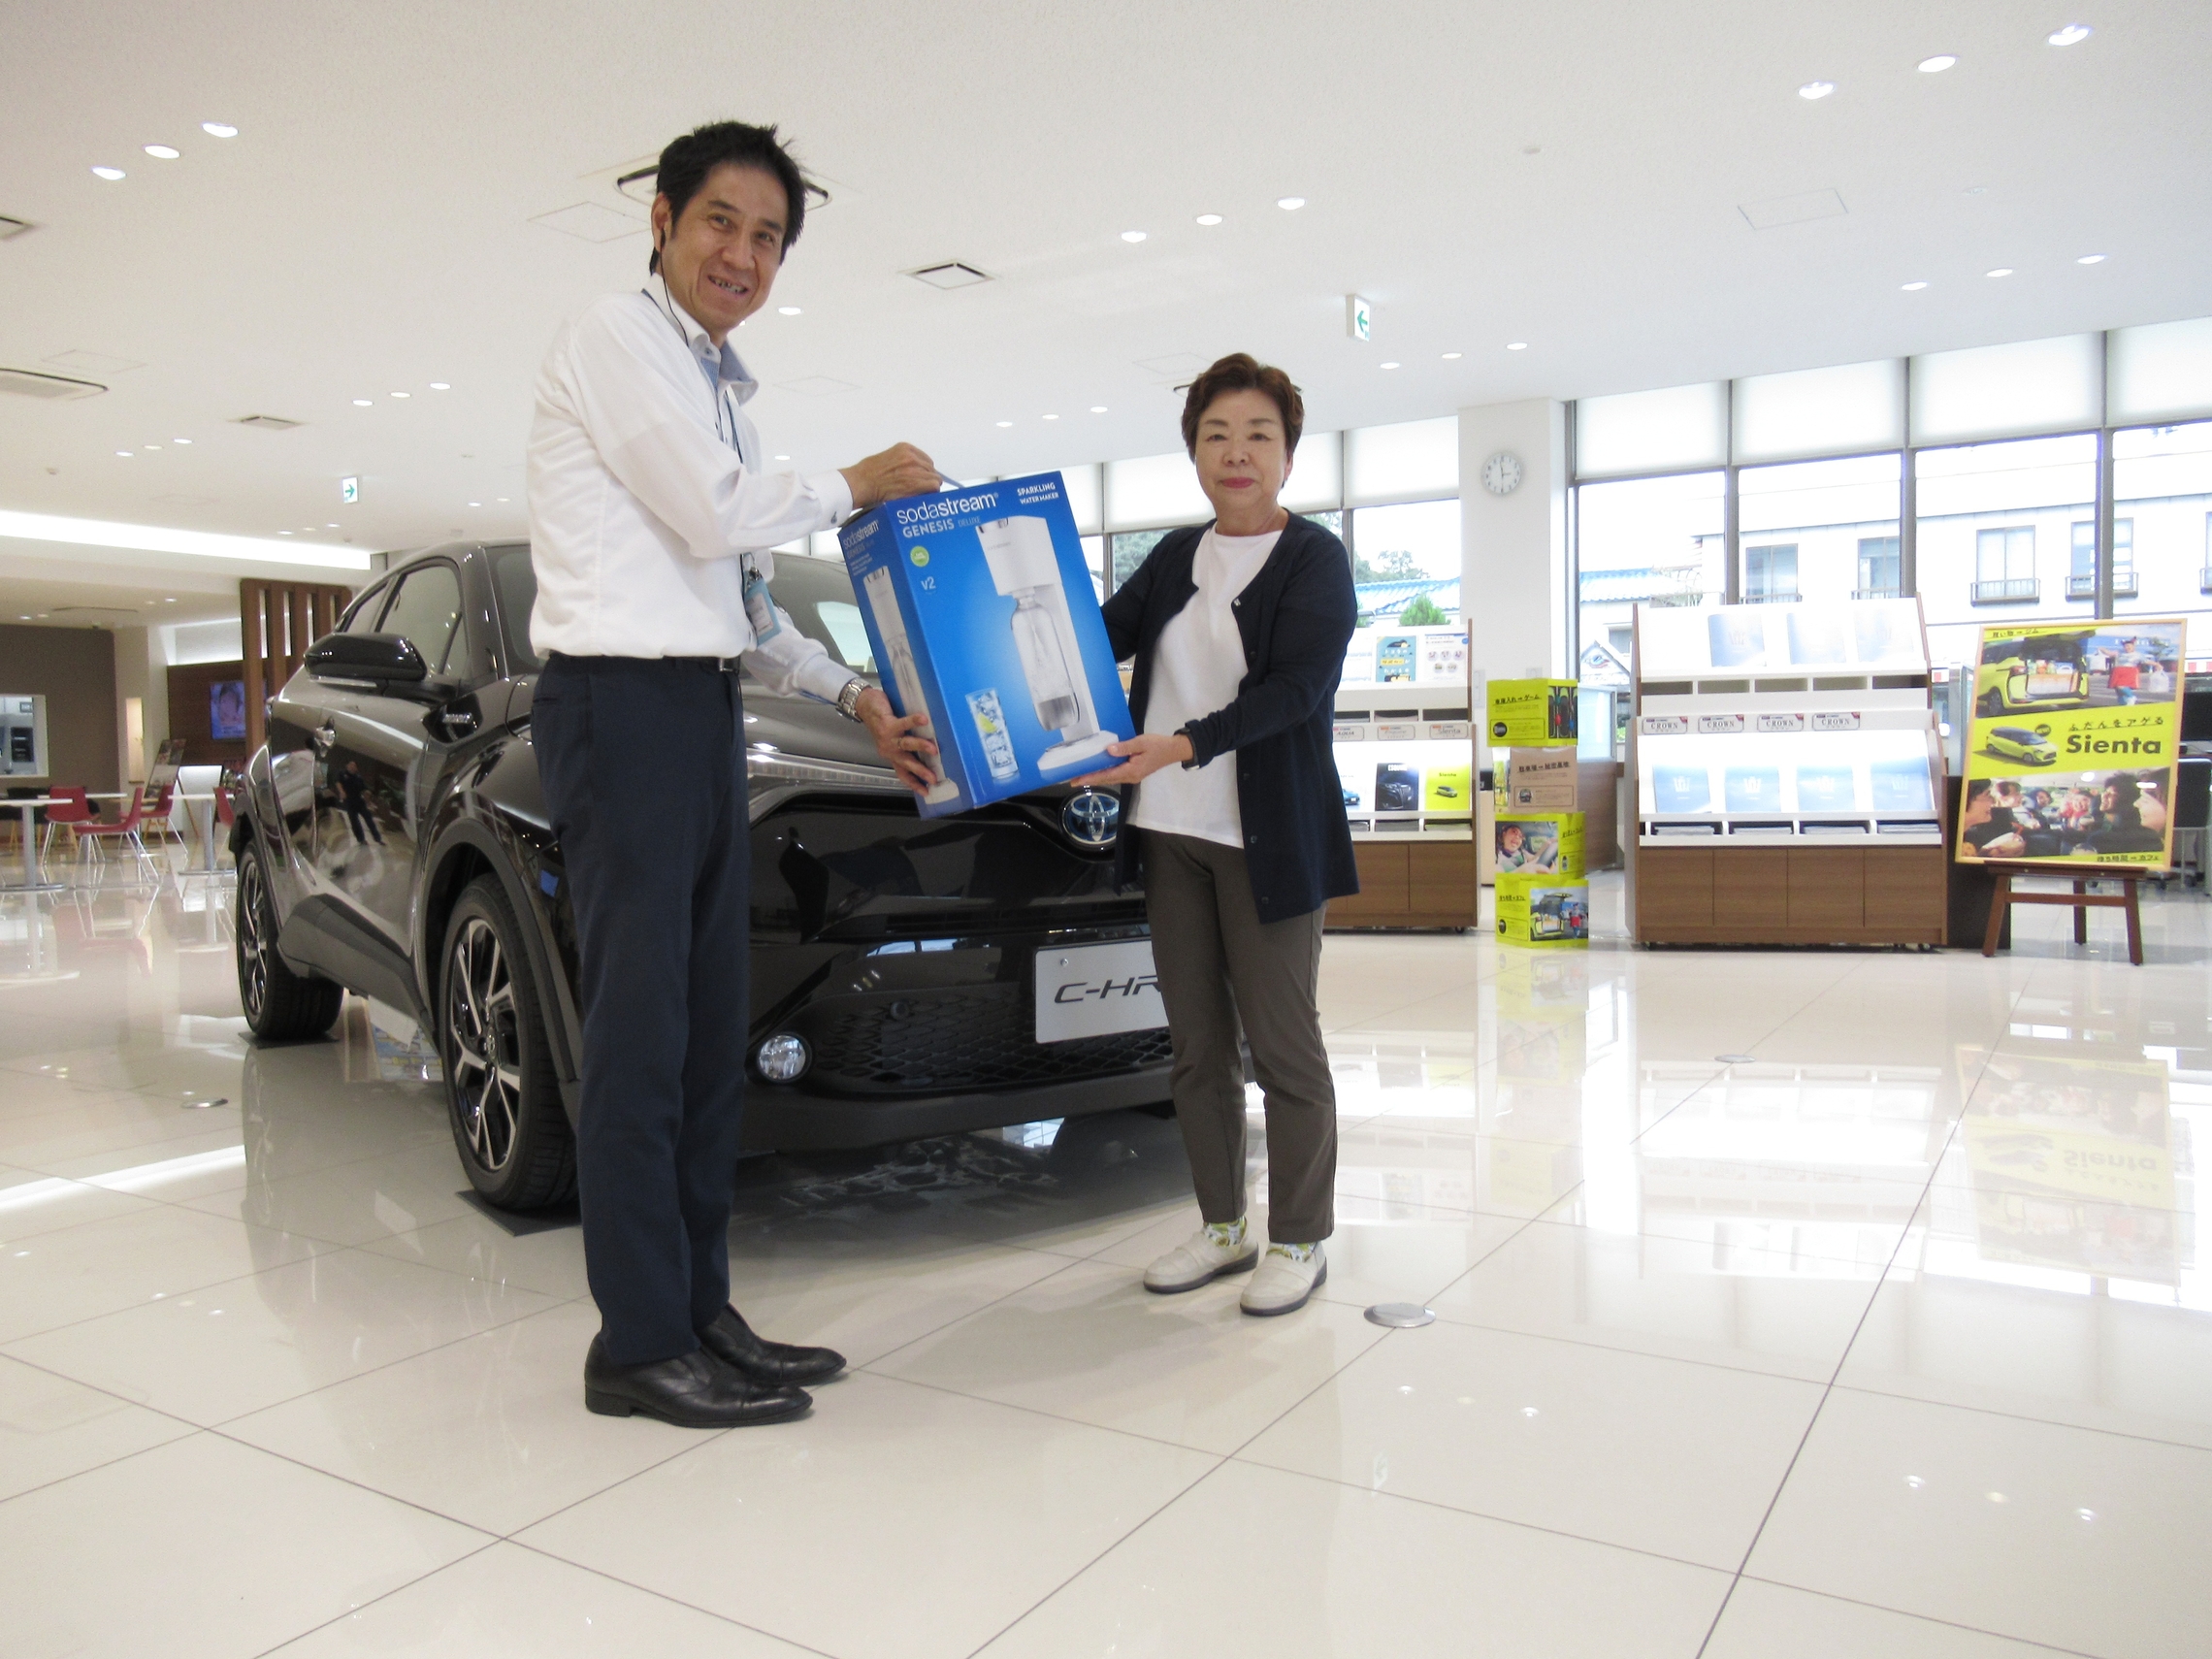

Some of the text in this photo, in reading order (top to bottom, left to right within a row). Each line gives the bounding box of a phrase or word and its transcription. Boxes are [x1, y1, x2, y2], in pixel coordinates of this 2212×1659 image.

[1017, 482, 1056, 496] SPARKLING
[1020, 492, 1059, 504] WATER MAKER
[896, 493, 997, 525] sodastream
[902, 518, 955, 538] GENESIS
[2066, 734, 2161, 754] Sienta
